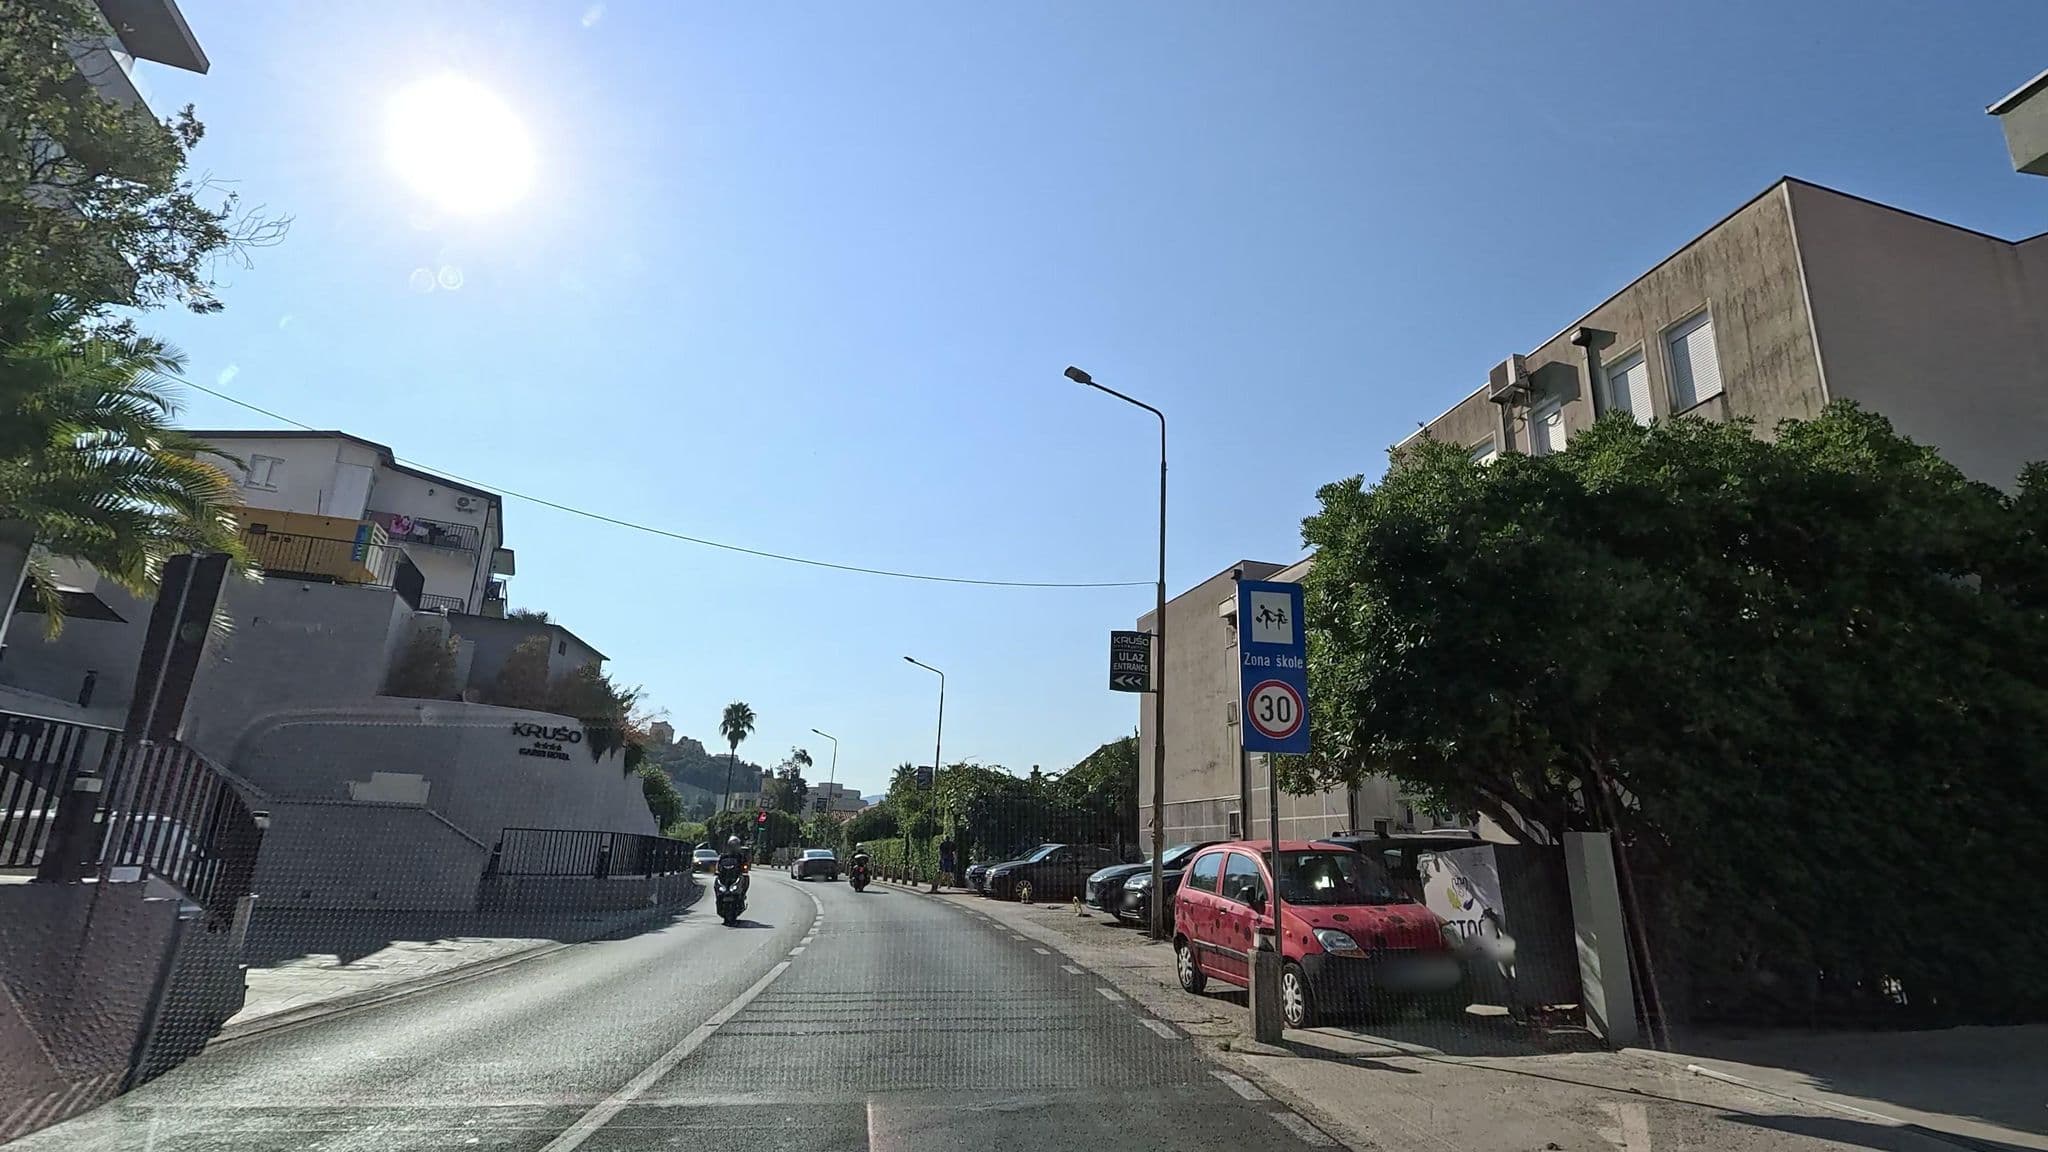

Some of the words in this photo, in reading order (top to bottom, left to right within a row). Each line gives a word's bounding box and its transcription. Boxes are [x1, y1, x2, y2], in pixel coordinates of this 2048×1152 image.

[1119, 652, 1144, 663] ULAZ
[1243, 652, 1271, 667] Zona
[1276, 654, 1304, 669] škole
[1113, 662, 1149, 673] ENTRANCE
[1260, 694, 1291, 723] 30
